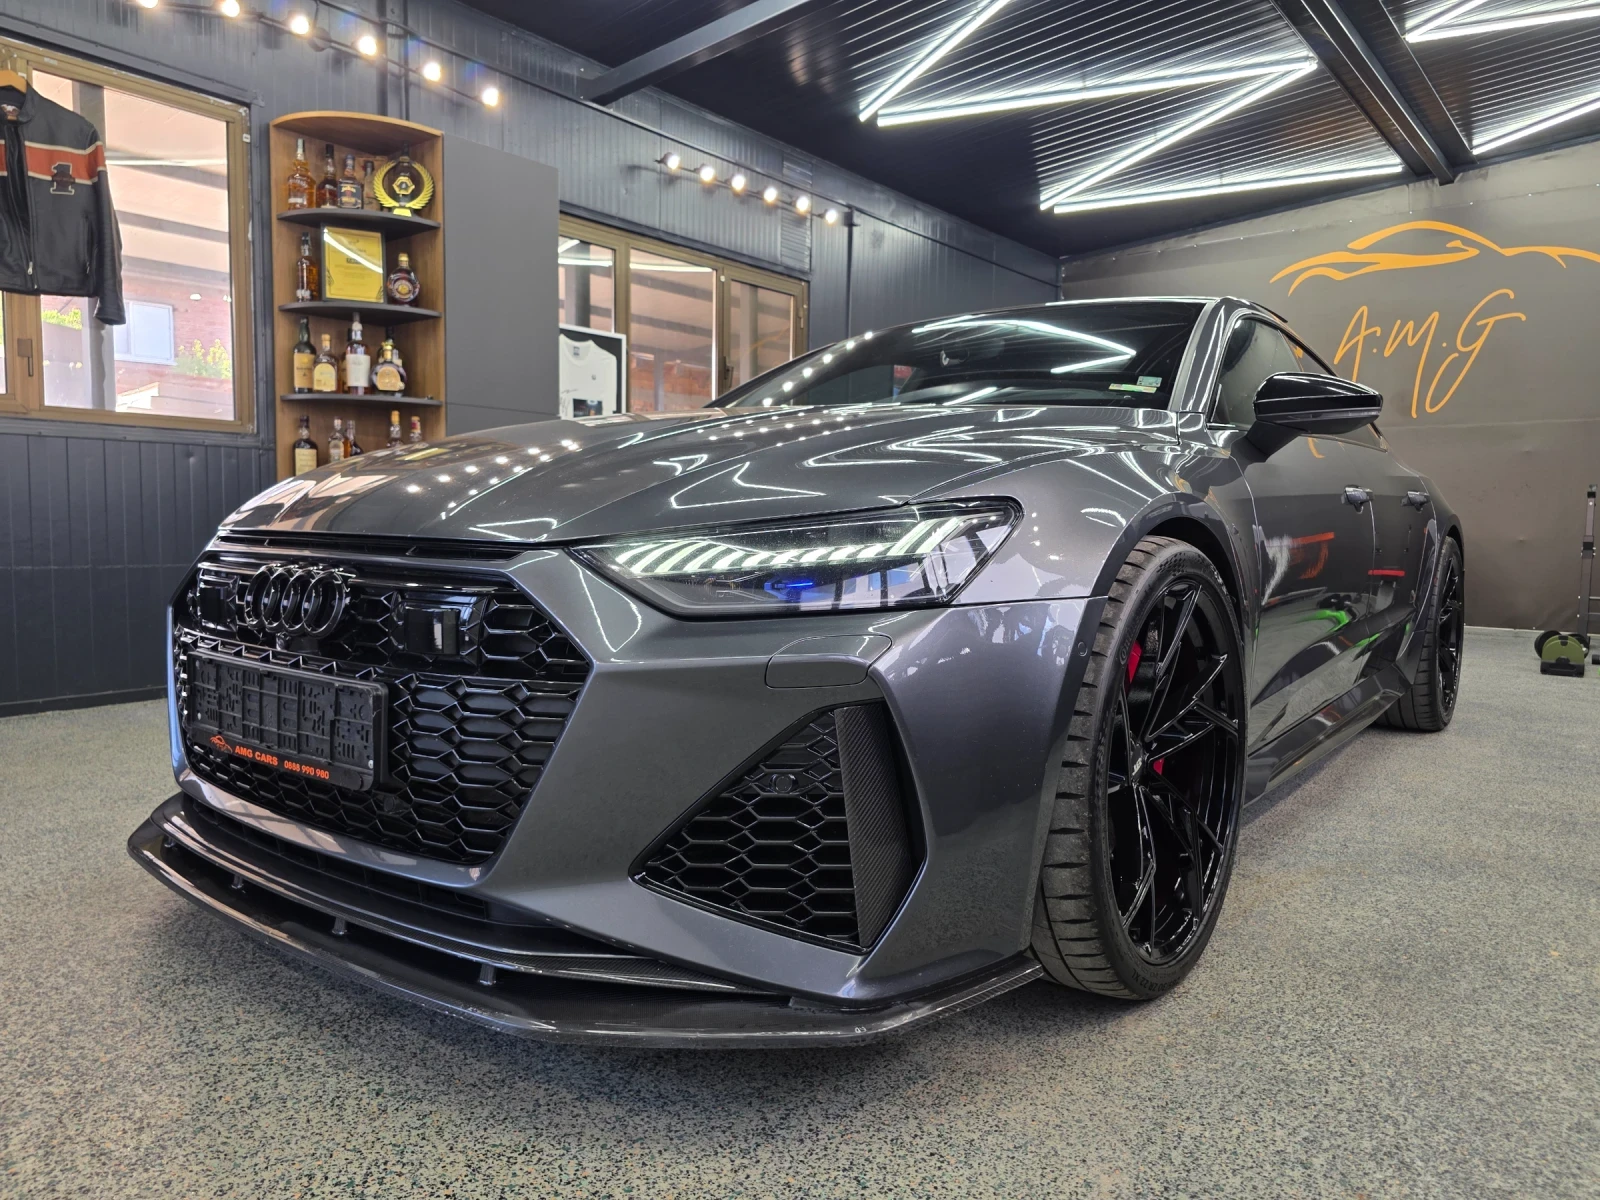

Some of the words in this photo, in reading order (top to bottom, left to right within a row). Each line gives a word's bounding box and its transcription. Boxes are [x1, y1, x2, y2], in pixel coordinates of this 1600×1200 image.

[234, 745, 253, 759] AMG
[254, 751, 279, 766] CARS
[301, 765, 315, 776] 990
[315, 768, 330, 779] 980
